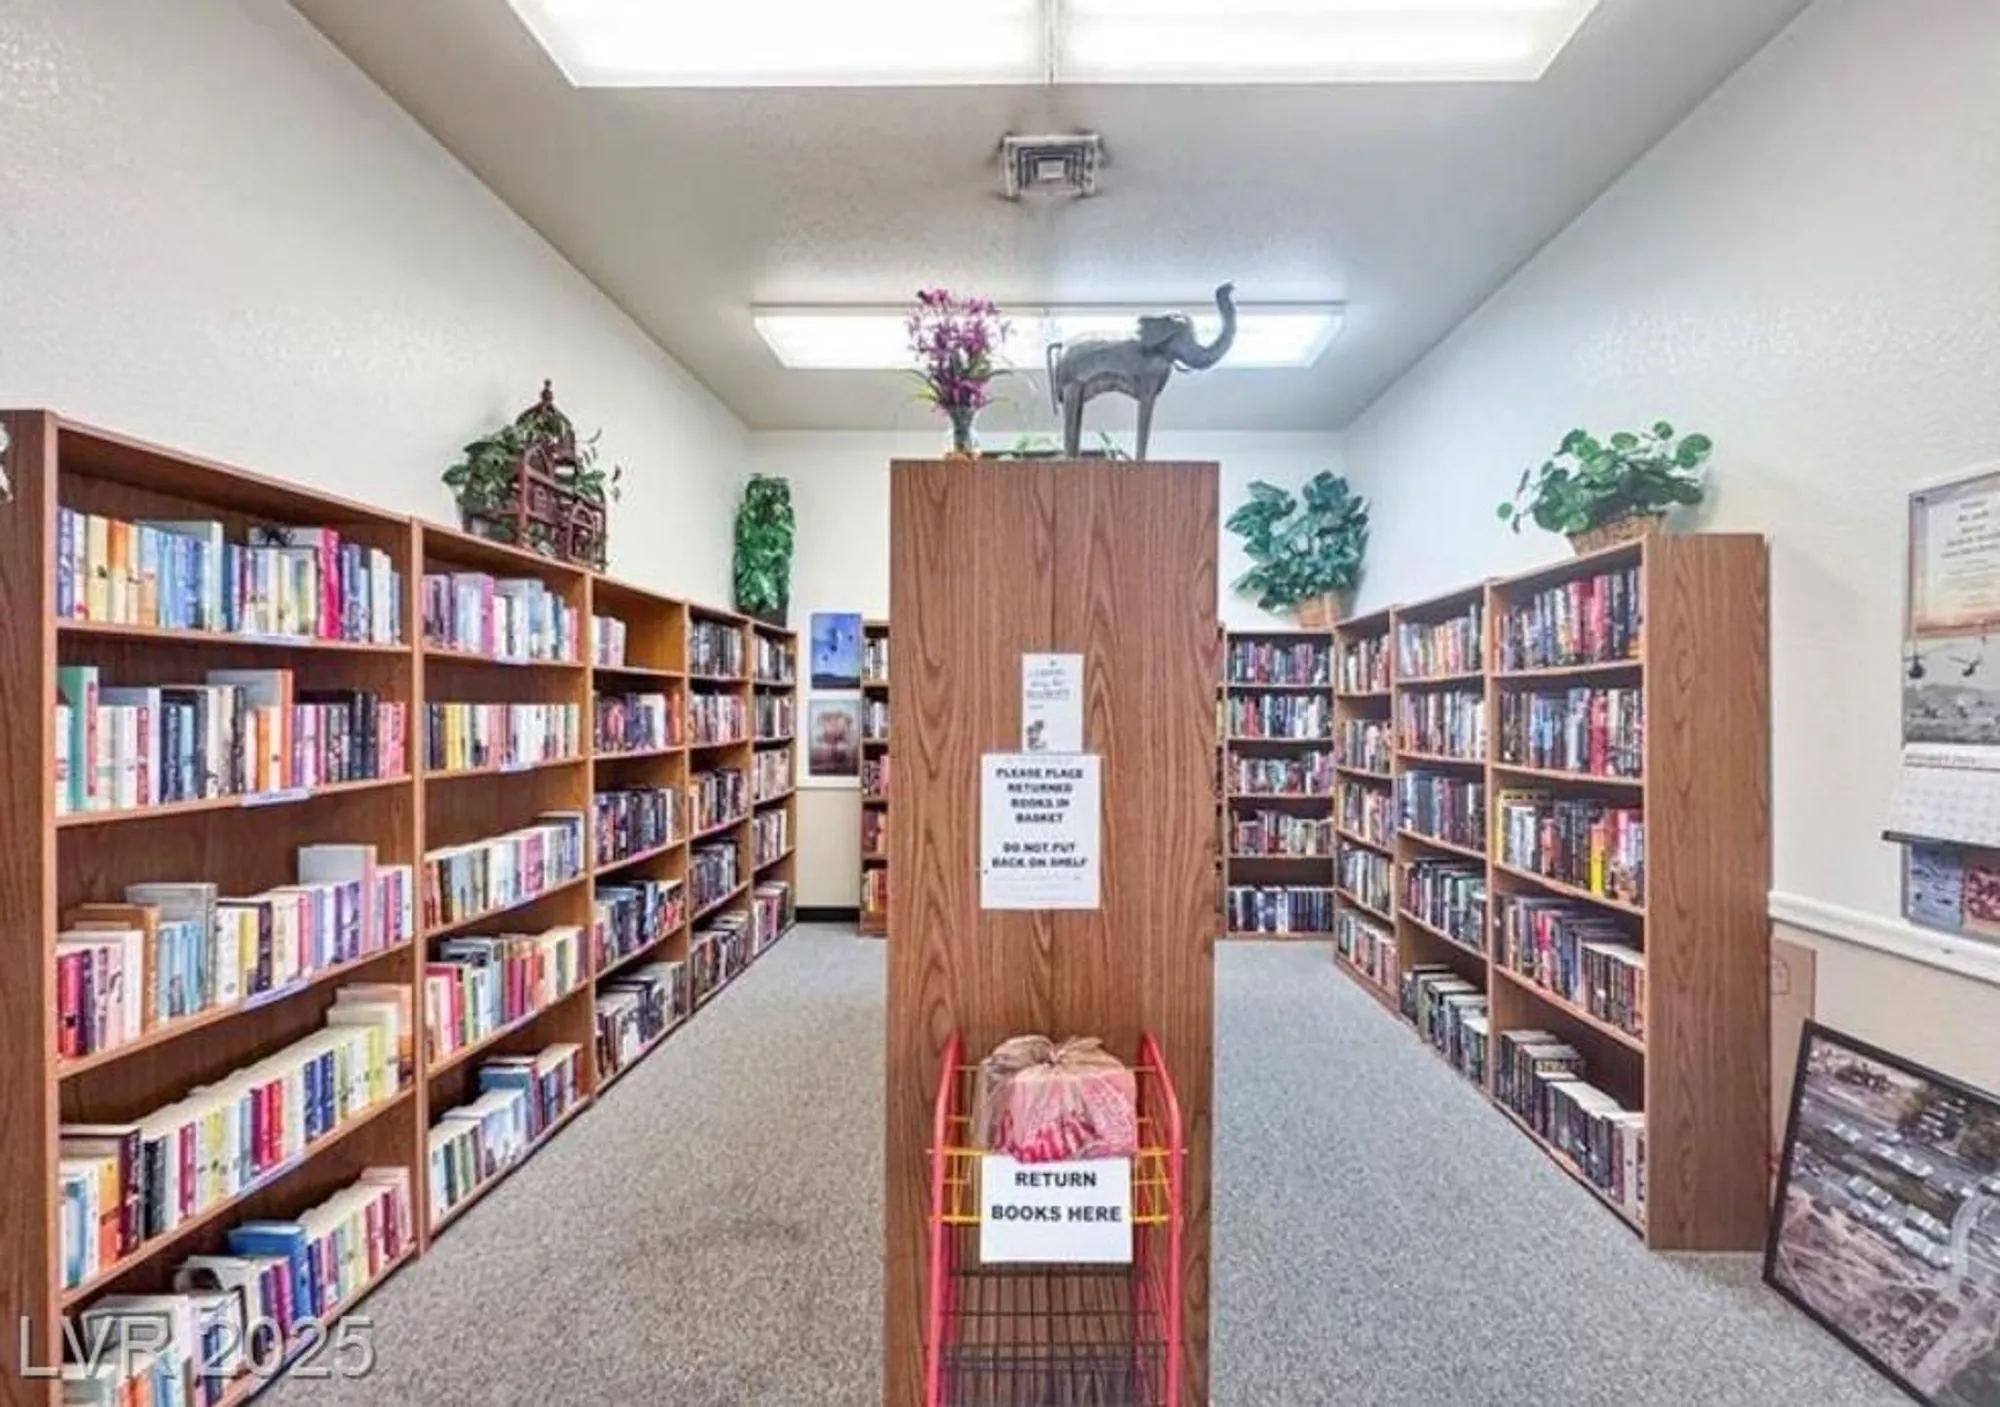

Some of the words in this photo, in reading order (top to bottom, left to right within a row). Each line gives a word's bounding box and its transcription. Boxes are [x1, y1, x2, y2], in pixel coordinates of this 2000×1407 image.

[996, 768, 1041, 779] PLEASE
[1045, 768, 1083, 779] PLACE
[1007, 783, 1072, 794] RETURNED
[1015, 812, 1063, 824] BASKET
[1003, 842, 1021, 854] DO
[1024, 842, 1049, 854] NOT
[1052, 842, 1076, 853] PUT
[992, 857, 1025, 869] BACK
[1028, 857, 1047, 868] ON
[1050, 857, 1087, 868] SHELF
[1014, 1171, 1098, 1187] RETURN
[991, 1205, 1061, 1222] BOOKS
[1067, 1205, 1122, 1222] HERE
